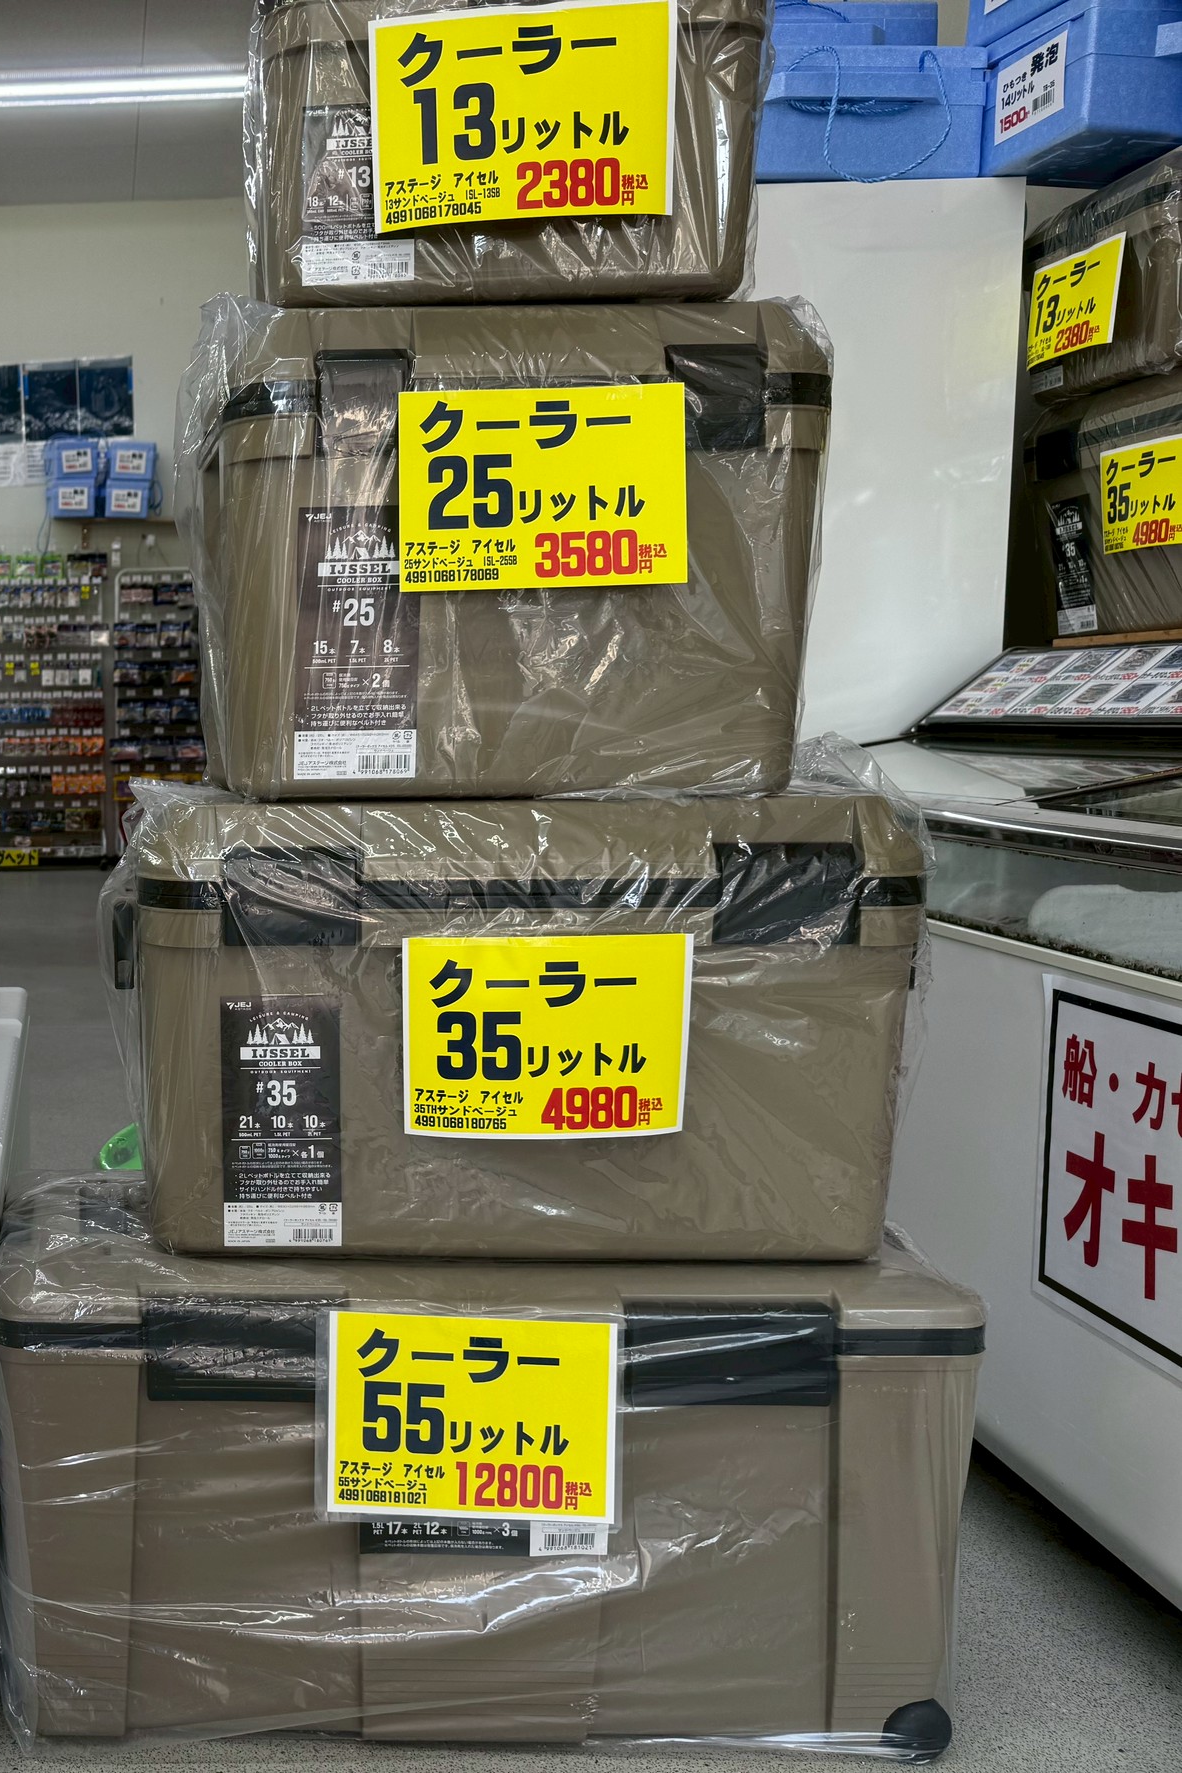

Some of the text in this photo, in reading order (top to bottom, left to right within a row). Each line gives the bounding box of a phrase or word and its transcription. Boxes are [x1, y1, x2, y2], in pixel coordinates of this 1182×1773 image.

[397, 24, 616, 88] クーラー
[1003, 42, 1059, 93] ひもつき 発泡
[1001, 80, 1035, 110] 14リットル
[413, 83, 629, 165] 13リットル
[1000, 106, 1026, 133] 1500
[384, 170, 498, 196] アステージ アイセル
[517, 158, 648, 210] 2380 税込
[384, 187, 500, 211] 13サンドベージュ ISL-13SB
[621, 191, 634, 206] 円
[386, 202, 482, 225] 4991068178045
[1037, 261, 1100, 300] クーラー
[1054, 320, 1090, 353] 2380
[419, 400, 631, 453] クーラー
[1106, 451, 1176, 485] クーラー
[428, 454, 645, 530] 25リットル
[1108, 482, 1176, 524] 35リットル
[1132, 518, 1170, 546] 4980
[406, 538, 515, 556] アステージ アイセル
[535, 529, 667, 578] 3580 税込
[330, 563, 390, 575] IJSSEL
[405, 556, 517, 570] 25サンドベージュ ISL-25SB
[406, 569, 498, 583] 4991068178069
[639, 559, 652, 573] 円
[313, 639, 400, 654] 15本 7本 8本
[430, 959, 637, 1008] クーラー
[252, 1048, 309, 1058] IJSSEL
[437, 1011, 646, 1080] 35リットル
[256, 1080, 297, 1106] #35
[415, 1089, 523, 1104] アステージ アイセル
[415, 1104, 517, 1117] 35THサンドベージュ
[541, 1086, 662, 1130] 4980 税込
[638, 1113, 650, 1125] 円
[239, 1115, 326, 1128] 21本 10本 10本
[415, 1115, 506, 1129] 4991068180765
[357, 1328, 559, 1383] クーラー
[362, 1381, 569, 1456] 55リットル
[340, 1460, 445, 1479] アステージ アイセル
[338, 1477, 427, 1491] 55サンドベージュ
[338, 1490, 427, 1504] 4991068181021
[456, 1462, 592, 1509] 12800 税込
[566, 1496, 578, 1509] 円
[387, 1522, 447, 1535] 17本 12本
